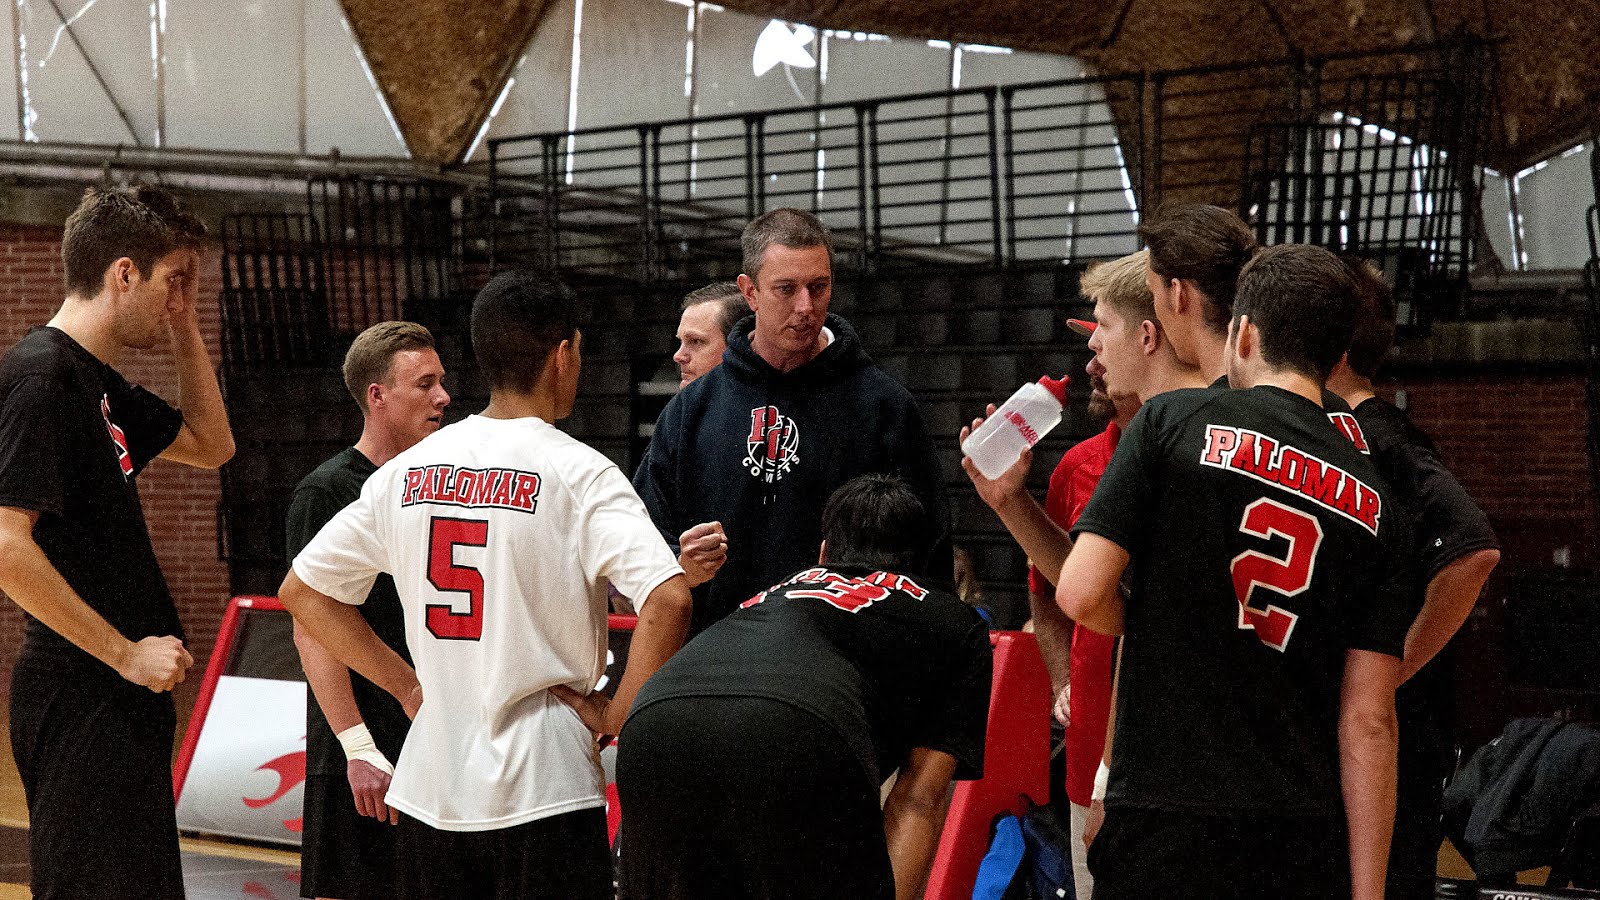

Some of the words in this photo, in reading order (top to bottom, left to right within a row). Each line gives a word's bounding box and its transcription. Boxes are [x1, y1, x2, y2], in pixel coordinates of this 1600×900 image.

[402, 464, 541, 514] PALOMAR
[1200, 424, 1381, 537] PALOMAR
[425, 516, 488, 641] 5
[1230, 497, 1324, 653] 2
